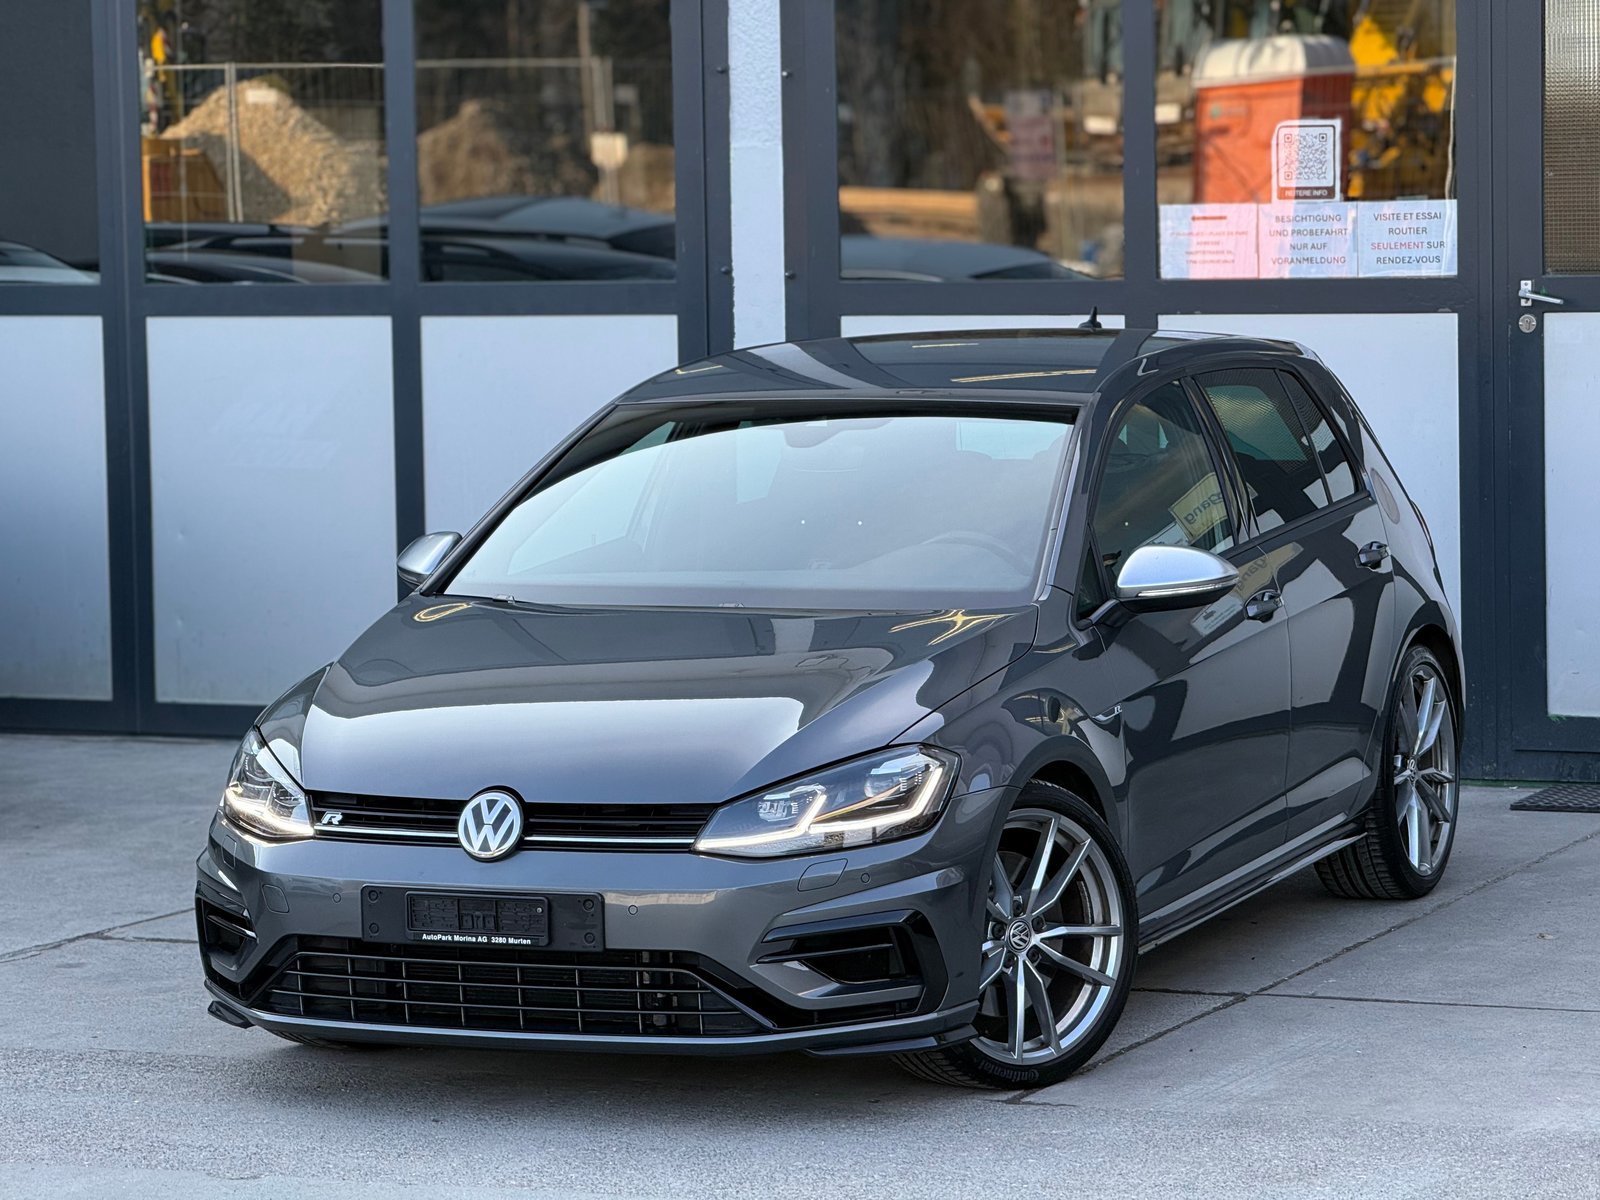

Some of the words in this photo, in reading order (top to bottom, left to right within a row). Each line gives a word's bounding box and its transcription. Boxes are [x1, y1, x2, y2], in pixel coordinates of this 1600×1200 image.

[1312, 189, 1328, 197] INFO
[1275, 214, 1342, 223] BESICHTIGUNG
[1373, 213, 1401, 221] VISITE
[1403, 212, 1414, 221] ET
[1415, 211, 1442, 220] ESSAI
[1269, 229, 1289, 237] UND
[1290, 227, 1348, 237] PROBEFAHRT
[1388, 226, 1428, 235] ROUTIER
[1289, 242, 1309, 251] NUR
[1310, 242, 1328, 251] AUF
[1371, 241, 1425, 250] SEULEMENT
[1426, 240, 1446, 249] SUR
[1271, 256, 1346, 265] VORANMELDUNG
[1376, 255, 1441, 265] RENDEZ-VOUS
[320, 811, 343, 826] R
[422, 933, 452, 941] AutoPark
[453, 935, 476, 943] Morina
[477, 935, 488, 943] AG
[508, 937, 531, 945] Murten
